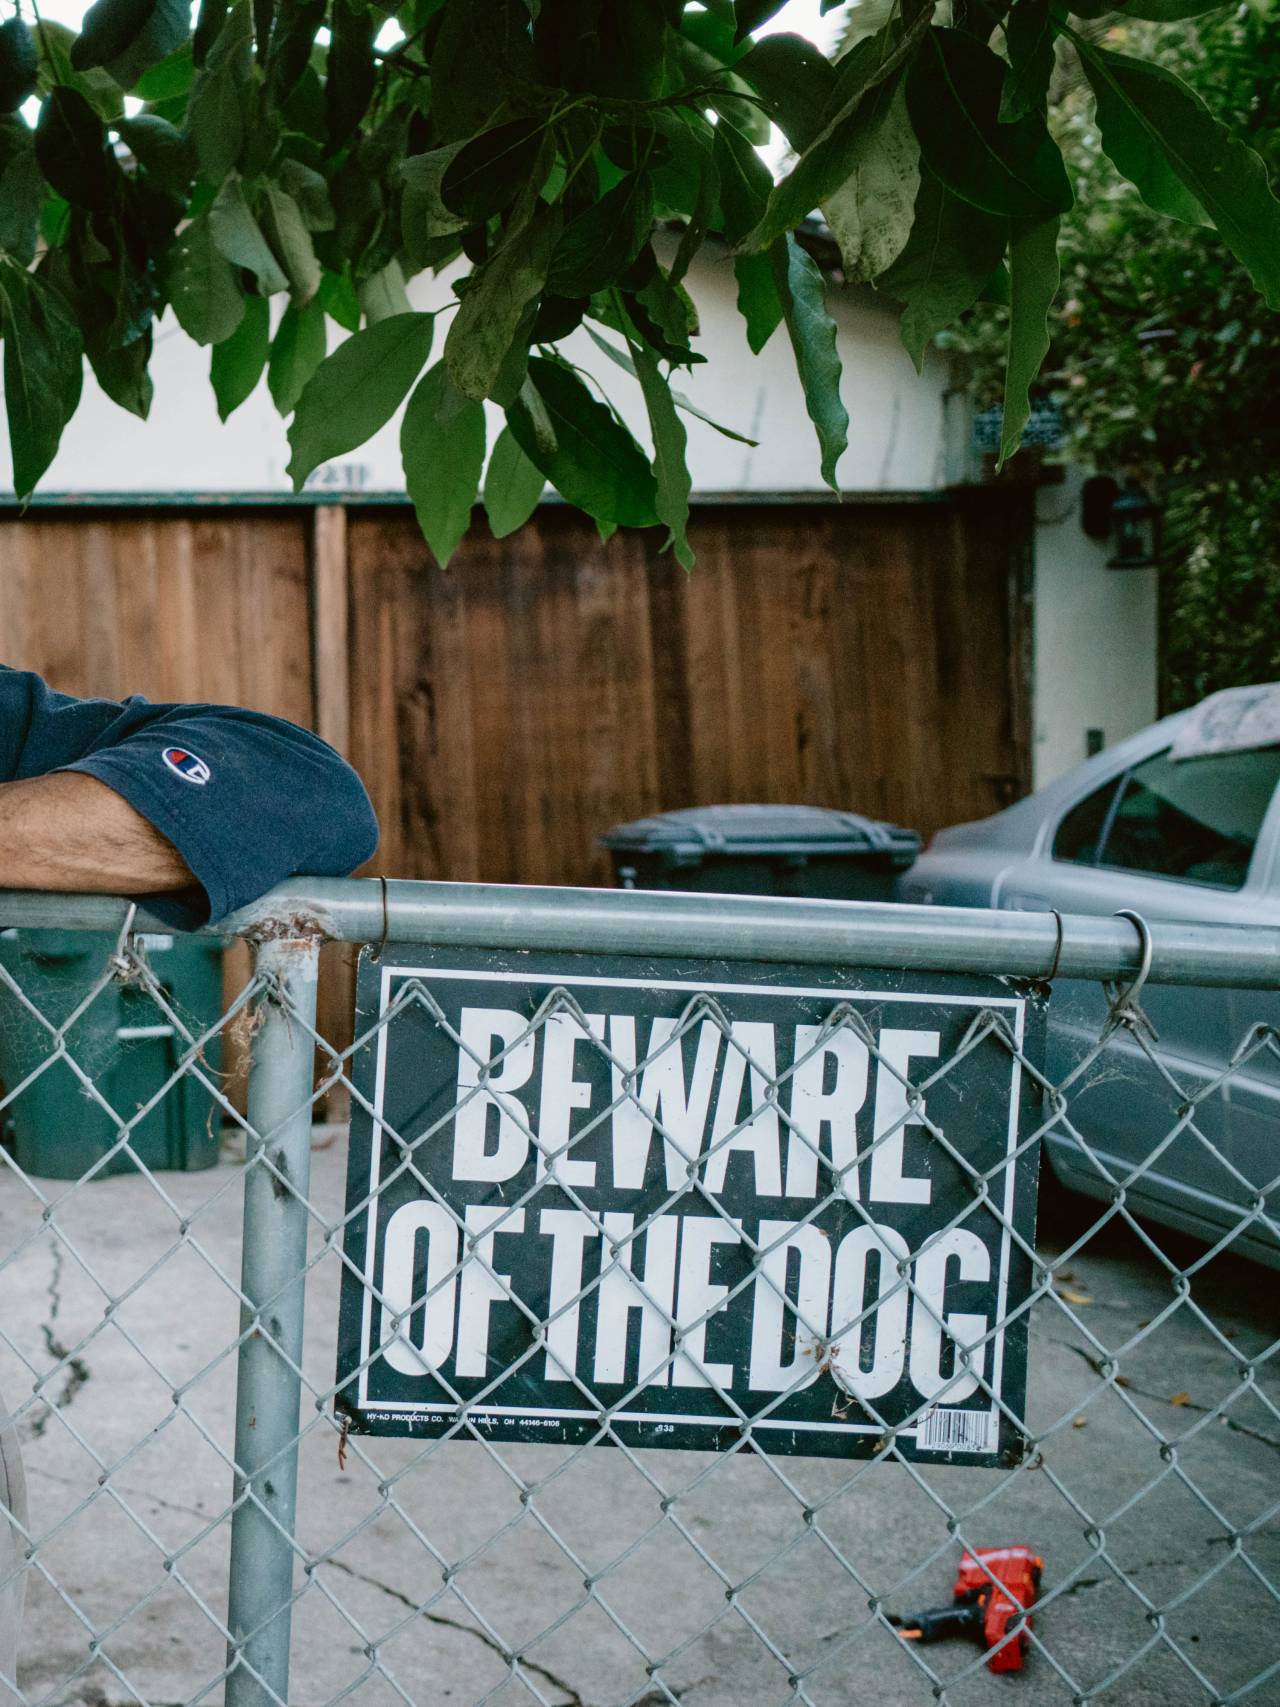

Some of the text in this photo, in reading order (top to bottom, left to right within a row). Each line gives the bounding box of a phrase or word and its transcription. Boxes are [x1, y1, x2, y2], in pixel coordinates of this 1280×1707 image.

[451, 1006, 941, 1206] BEWARE
[380, 1198, 993, 1405] OF THE DOG
[391, 1413, 430, 1422] PRODUCTS
[431, 1415, 444, 1423] CO.
